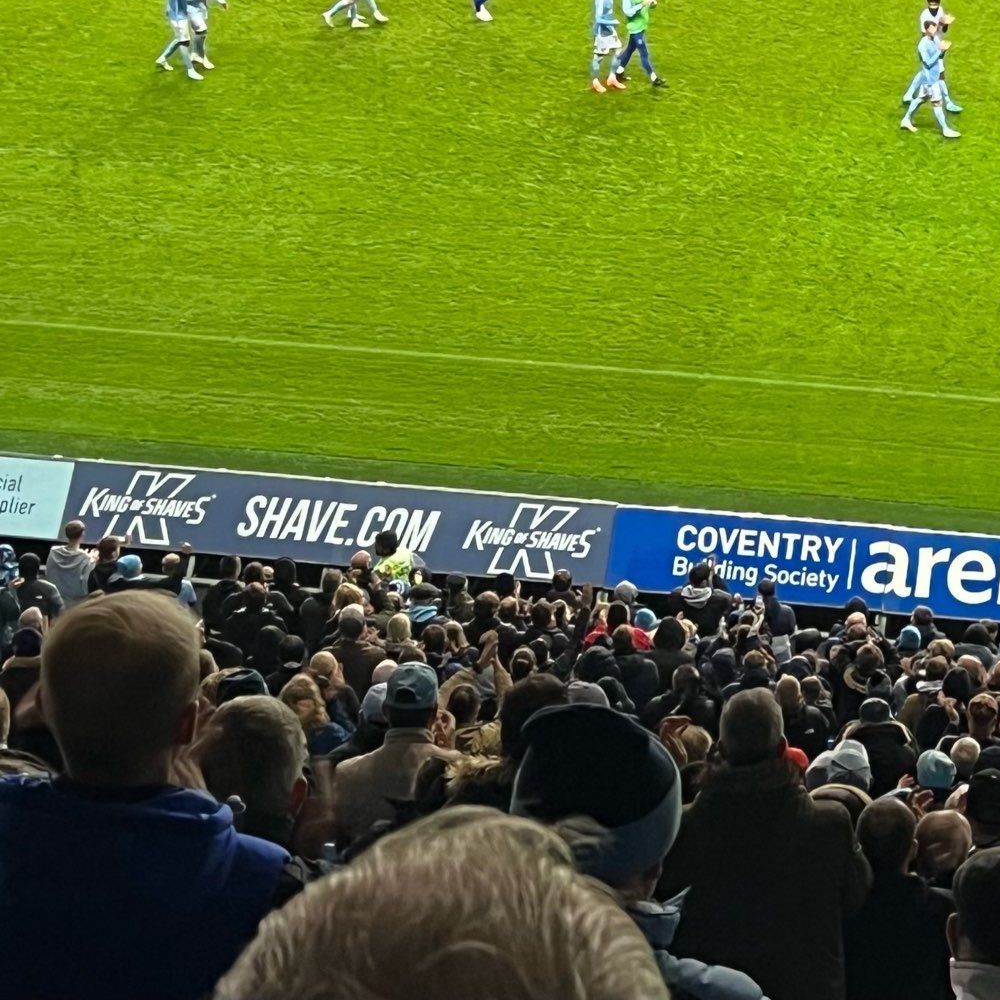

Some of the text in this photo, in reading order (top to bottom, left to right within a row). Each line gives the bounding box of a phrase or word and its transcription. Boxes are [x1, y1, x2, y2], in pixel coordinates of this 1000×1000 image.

[79, 487, 132, 518] KING
[141, 497, 211, 525] SHAVES
[237, 495, 442, 552] SHAVE.COM
[462, 519, 516, 551] KING
[525, 529, 597, 559] SHAVES
[677, 524, 845, 564] COVENTRY
[764, 563, 840, 594] Society
